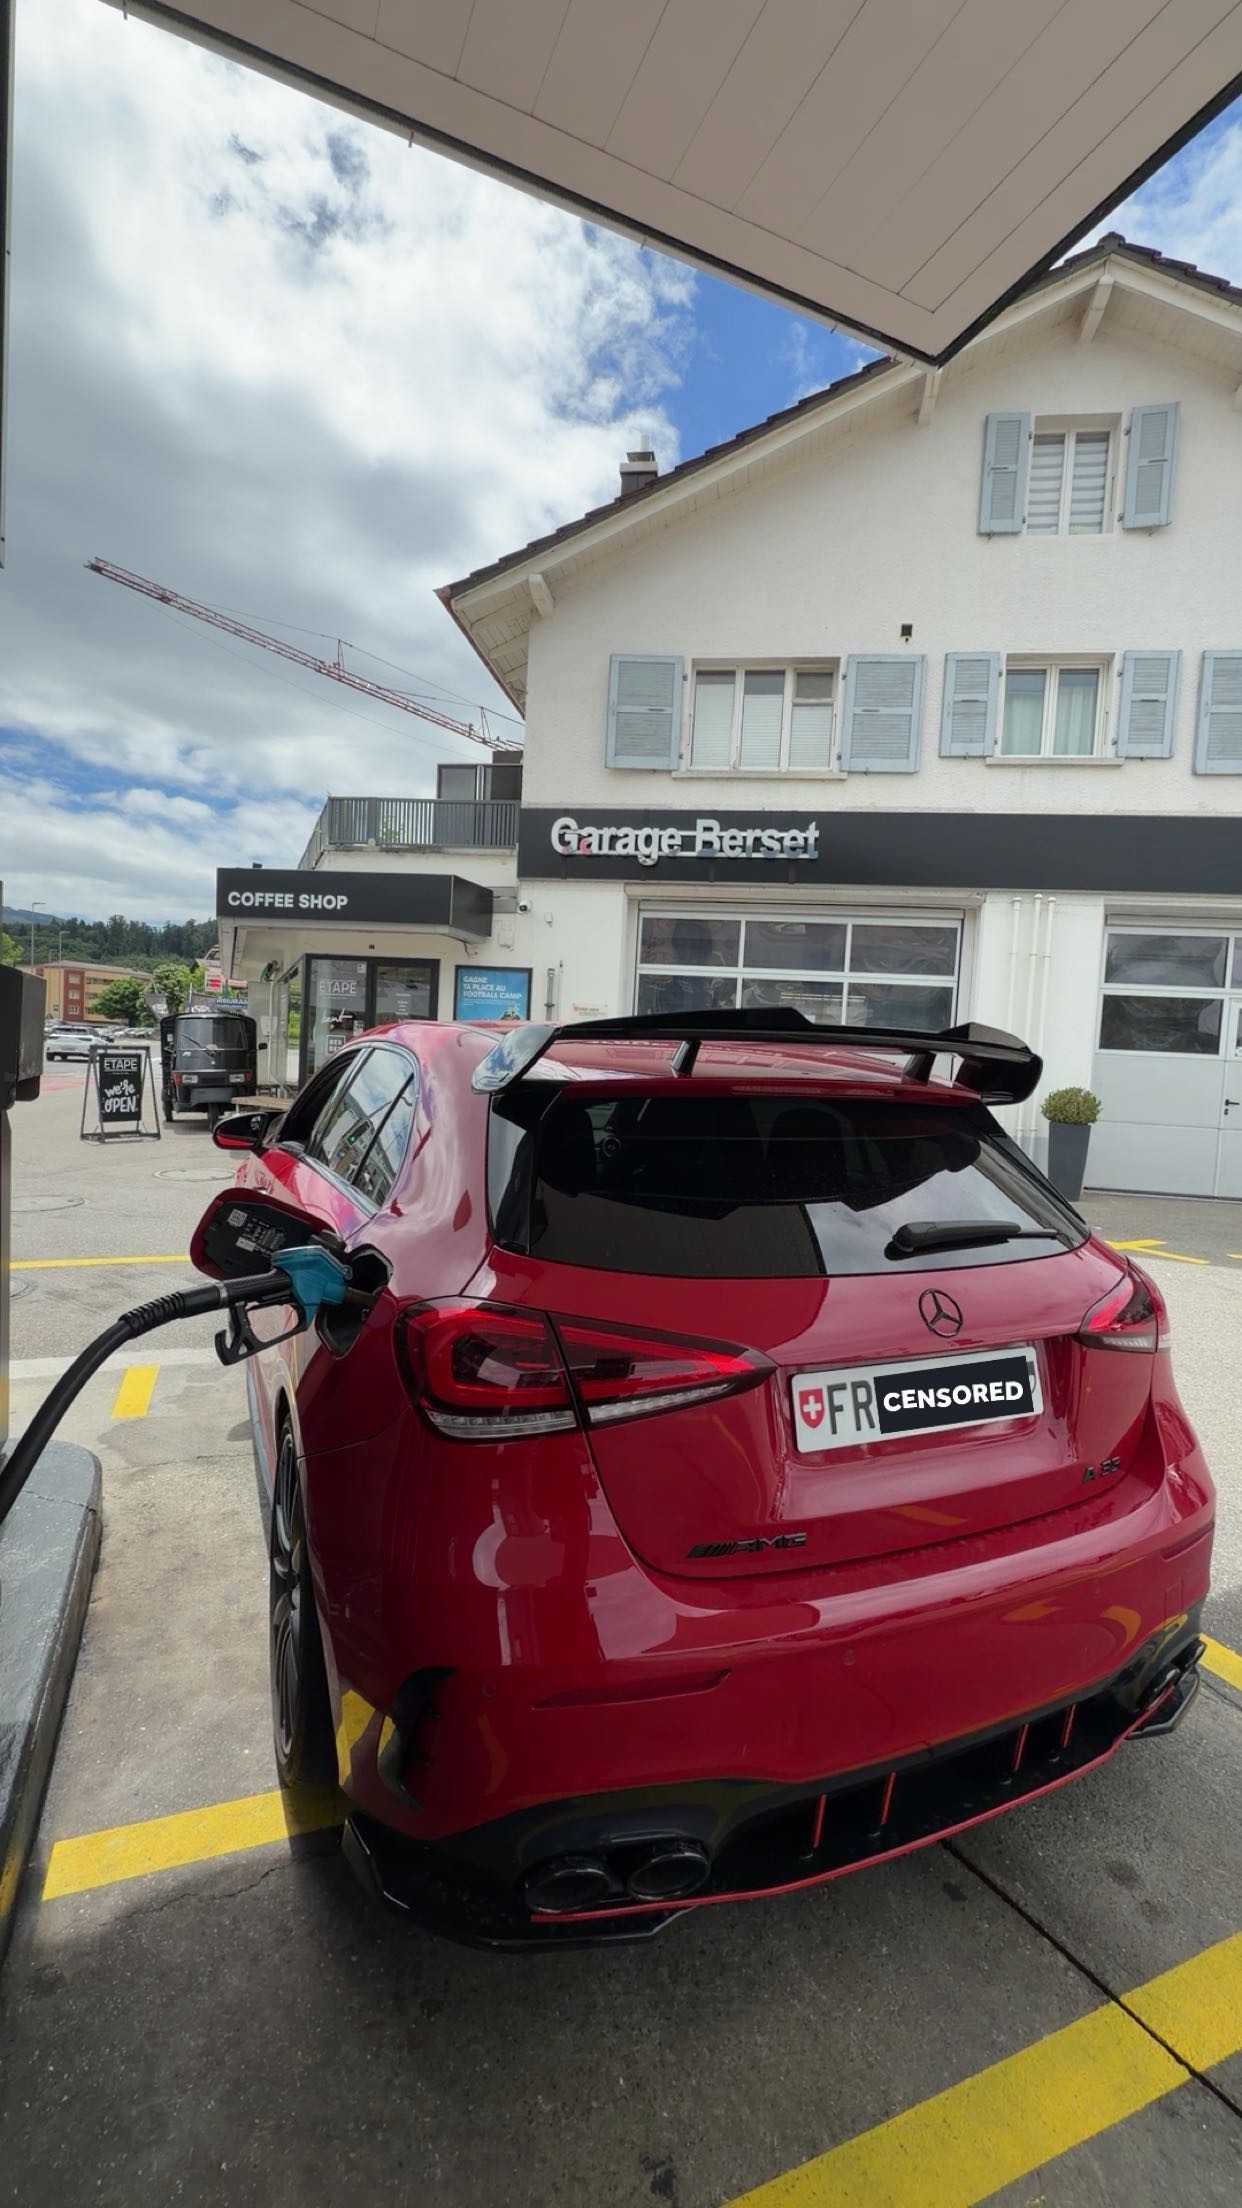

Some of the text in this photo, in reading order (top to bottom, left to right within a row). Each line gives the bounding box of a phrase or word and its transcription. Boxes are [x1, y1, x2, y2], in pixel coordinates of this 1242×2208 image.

[550, 817, 820, 866] Garage Berset
[228, 891, 348, 910] COFFEE SHOP
[319, 981, 357, 995] ETAPE
[104, 1059, 138, 1070] ETAPE
[104, 1096, 137, 1112] OPEN
[827, 1380, 876, 1435] FR
